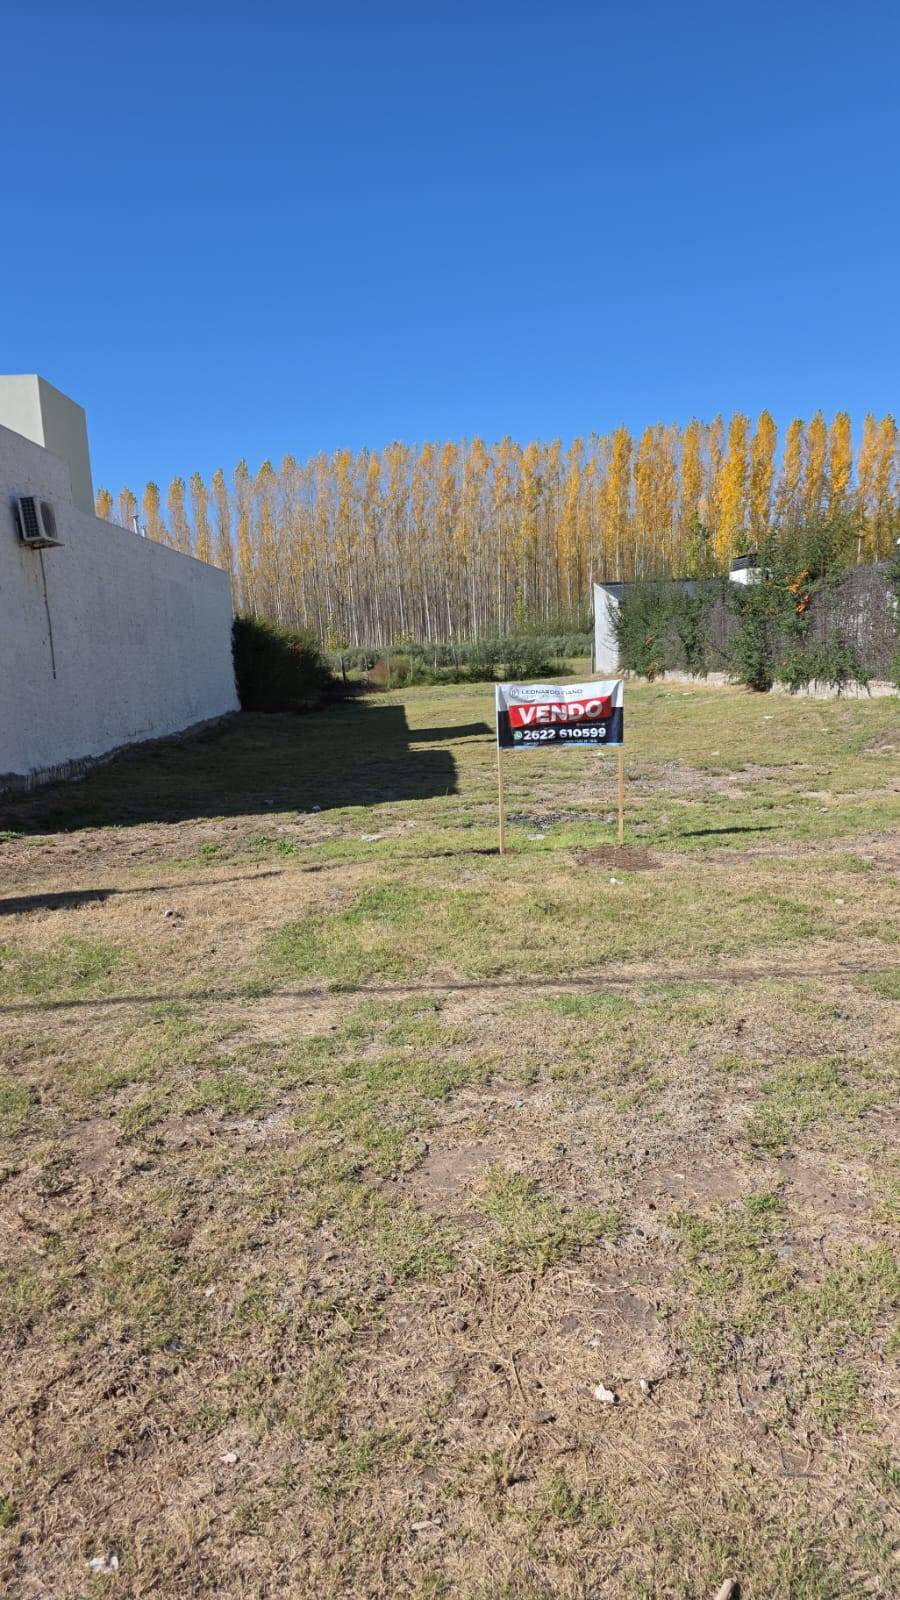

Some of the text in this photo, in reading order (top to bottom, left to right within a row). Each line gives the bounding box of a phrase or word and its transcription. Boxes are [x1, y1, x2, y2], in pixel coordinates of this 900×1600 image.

[518, 700, 603, 724] VENDO
[523, 727, 607, 740] 2622 610599
